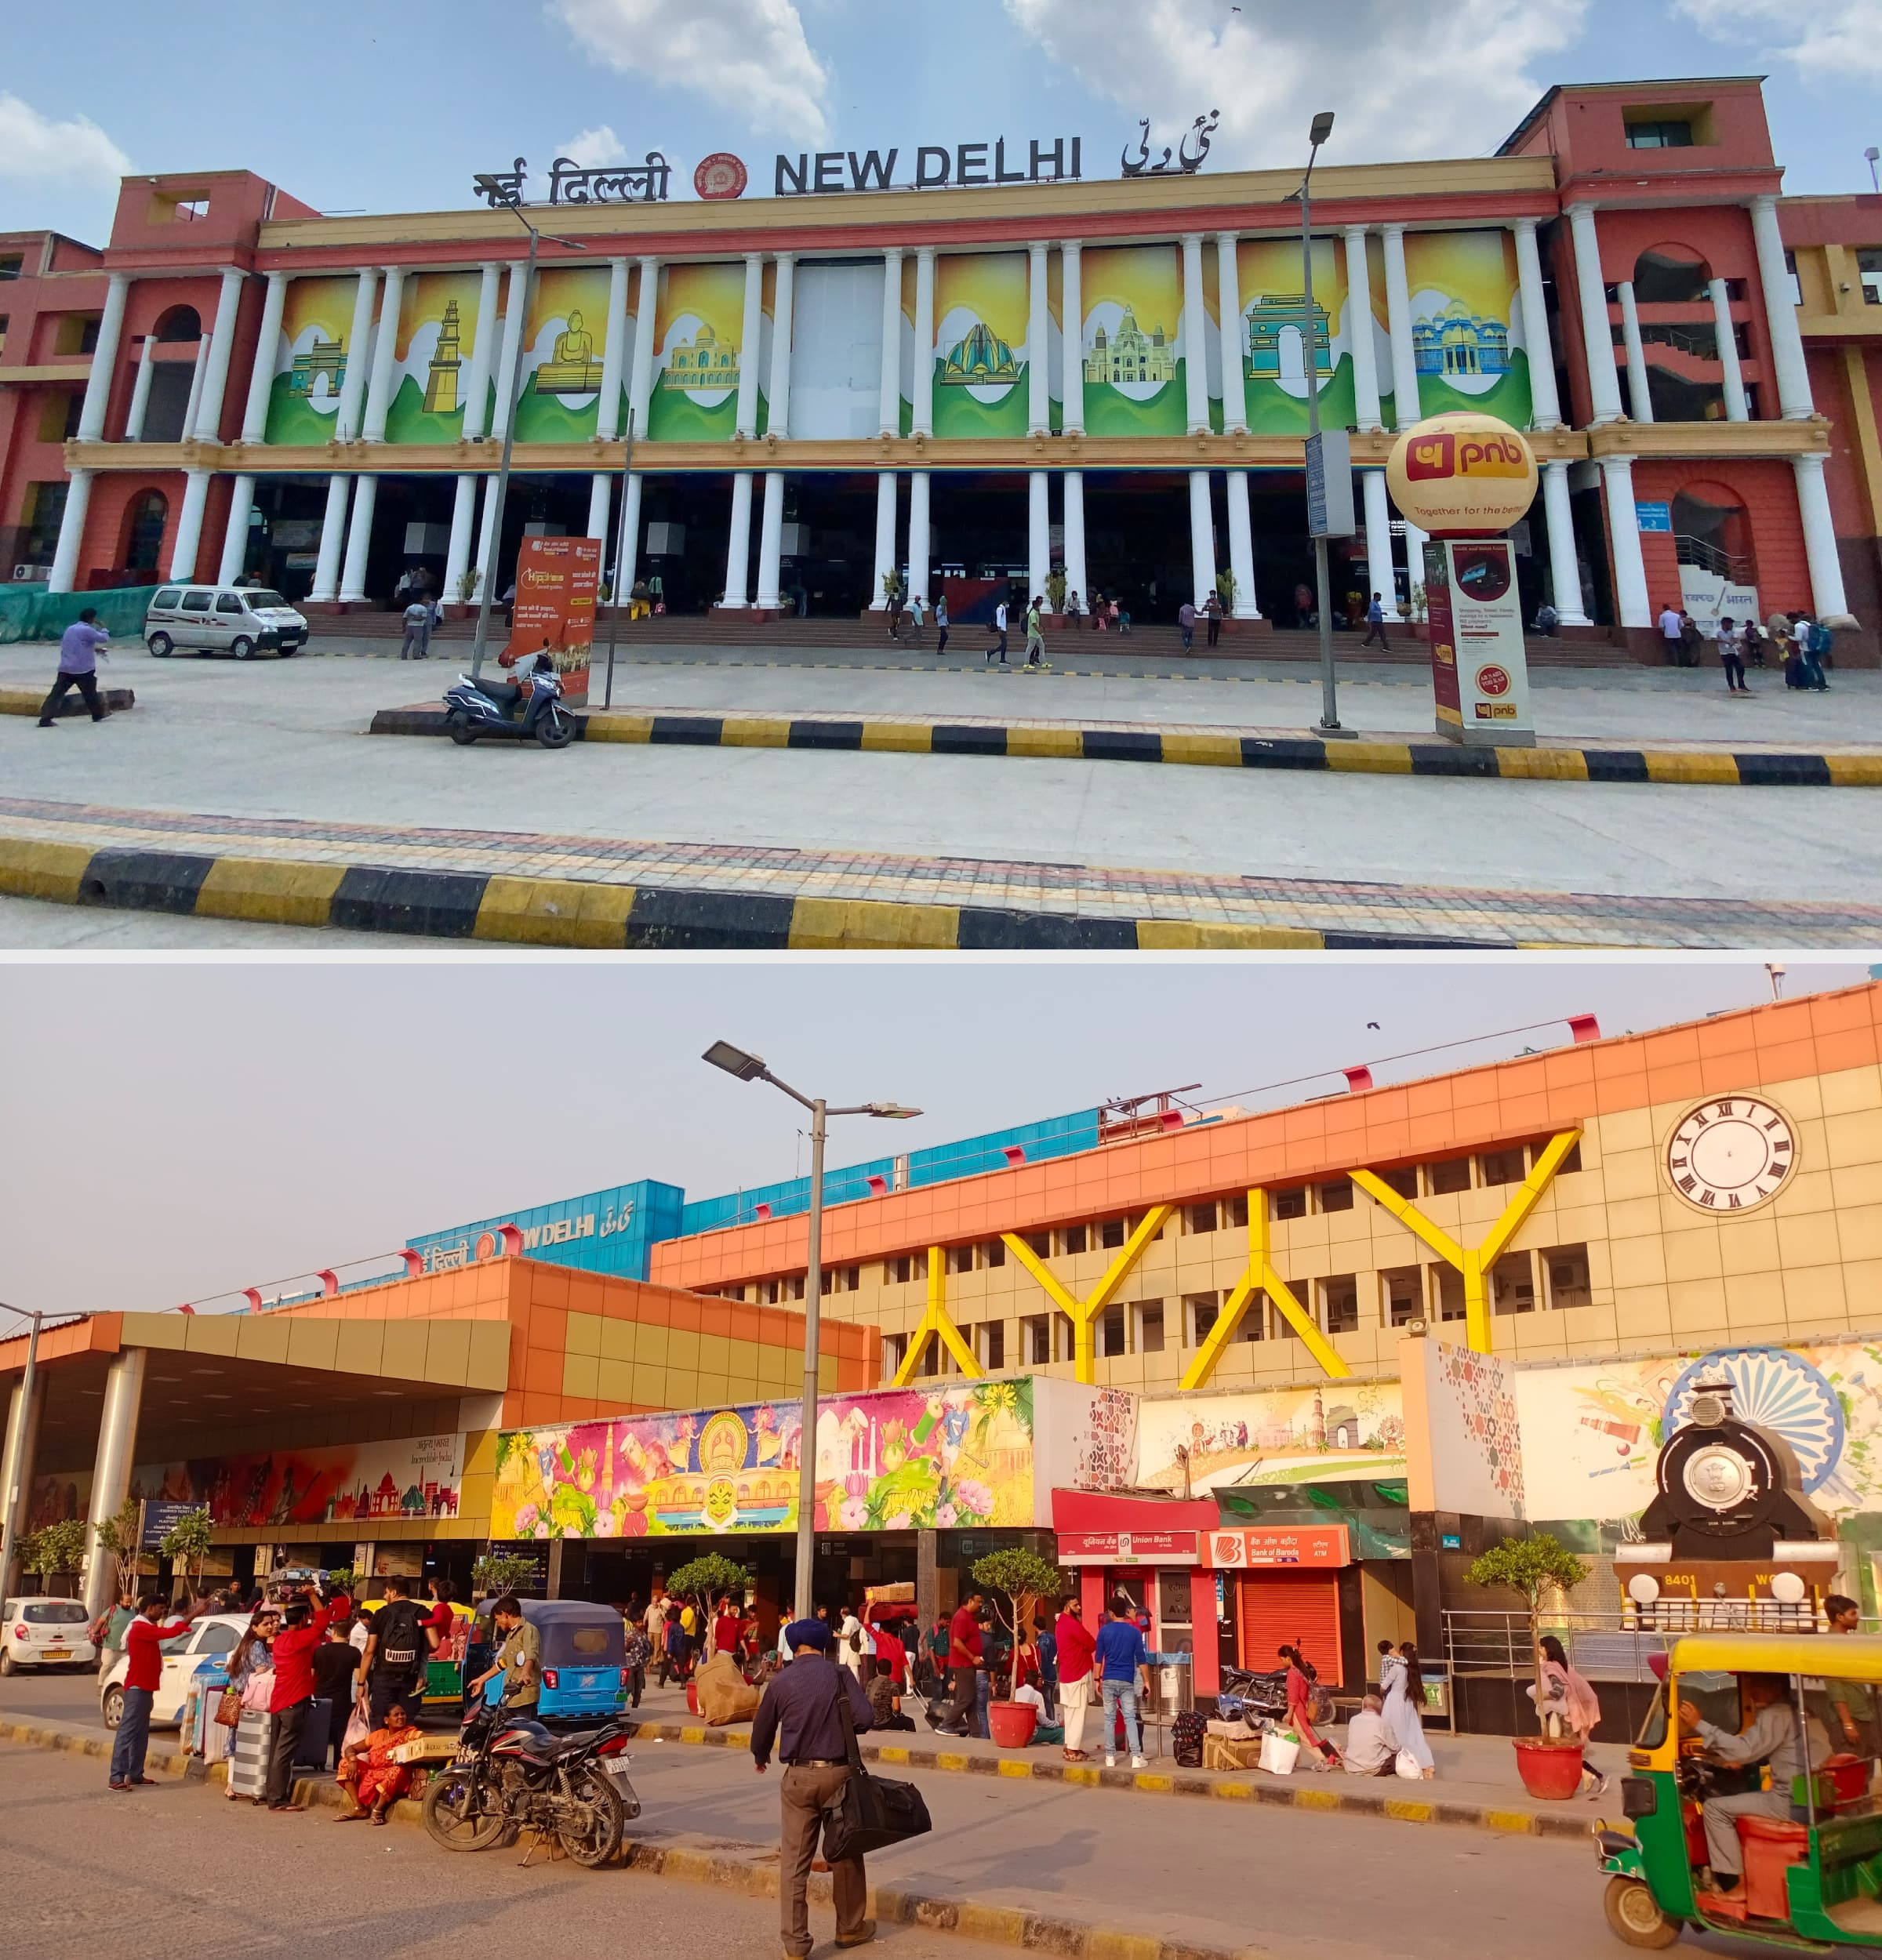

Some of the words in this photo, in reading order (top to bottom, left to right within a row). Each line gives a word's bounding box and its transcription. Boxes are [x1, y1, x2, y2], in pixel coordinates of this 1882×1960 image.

[548, 152, 672, 205] दिल्ली
[775, 148, 899, 195] NEW
[916, 136, 1081, 187] DELHI
[1460, 436, 1522, 472] pnb
[1414, 506, 1460, 517] Together
[1465, 506, 1481, 515] for
[1494, 705, 1515, 718] pnb
[542, 1214, 595, 1247] DELHI
[1665, 1574, 1695, 1585] 8401
